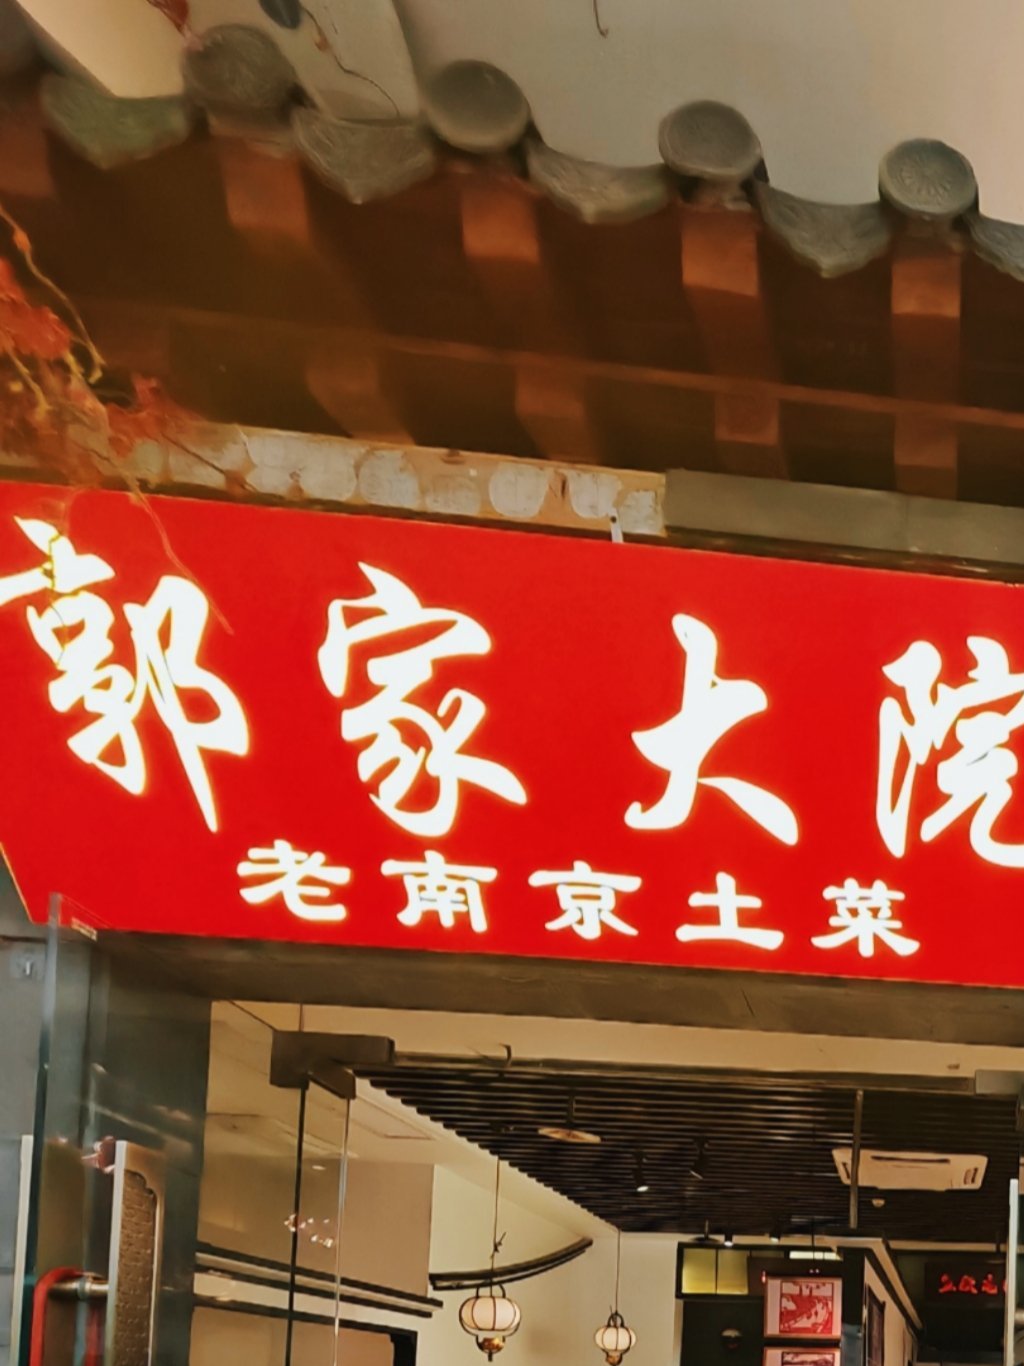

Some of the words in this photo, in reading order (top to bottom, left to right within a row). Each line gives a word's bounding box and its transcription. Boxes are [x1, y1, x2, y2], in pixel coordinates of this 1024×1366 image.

[236, 838, 921, 958] 老南京土菜
